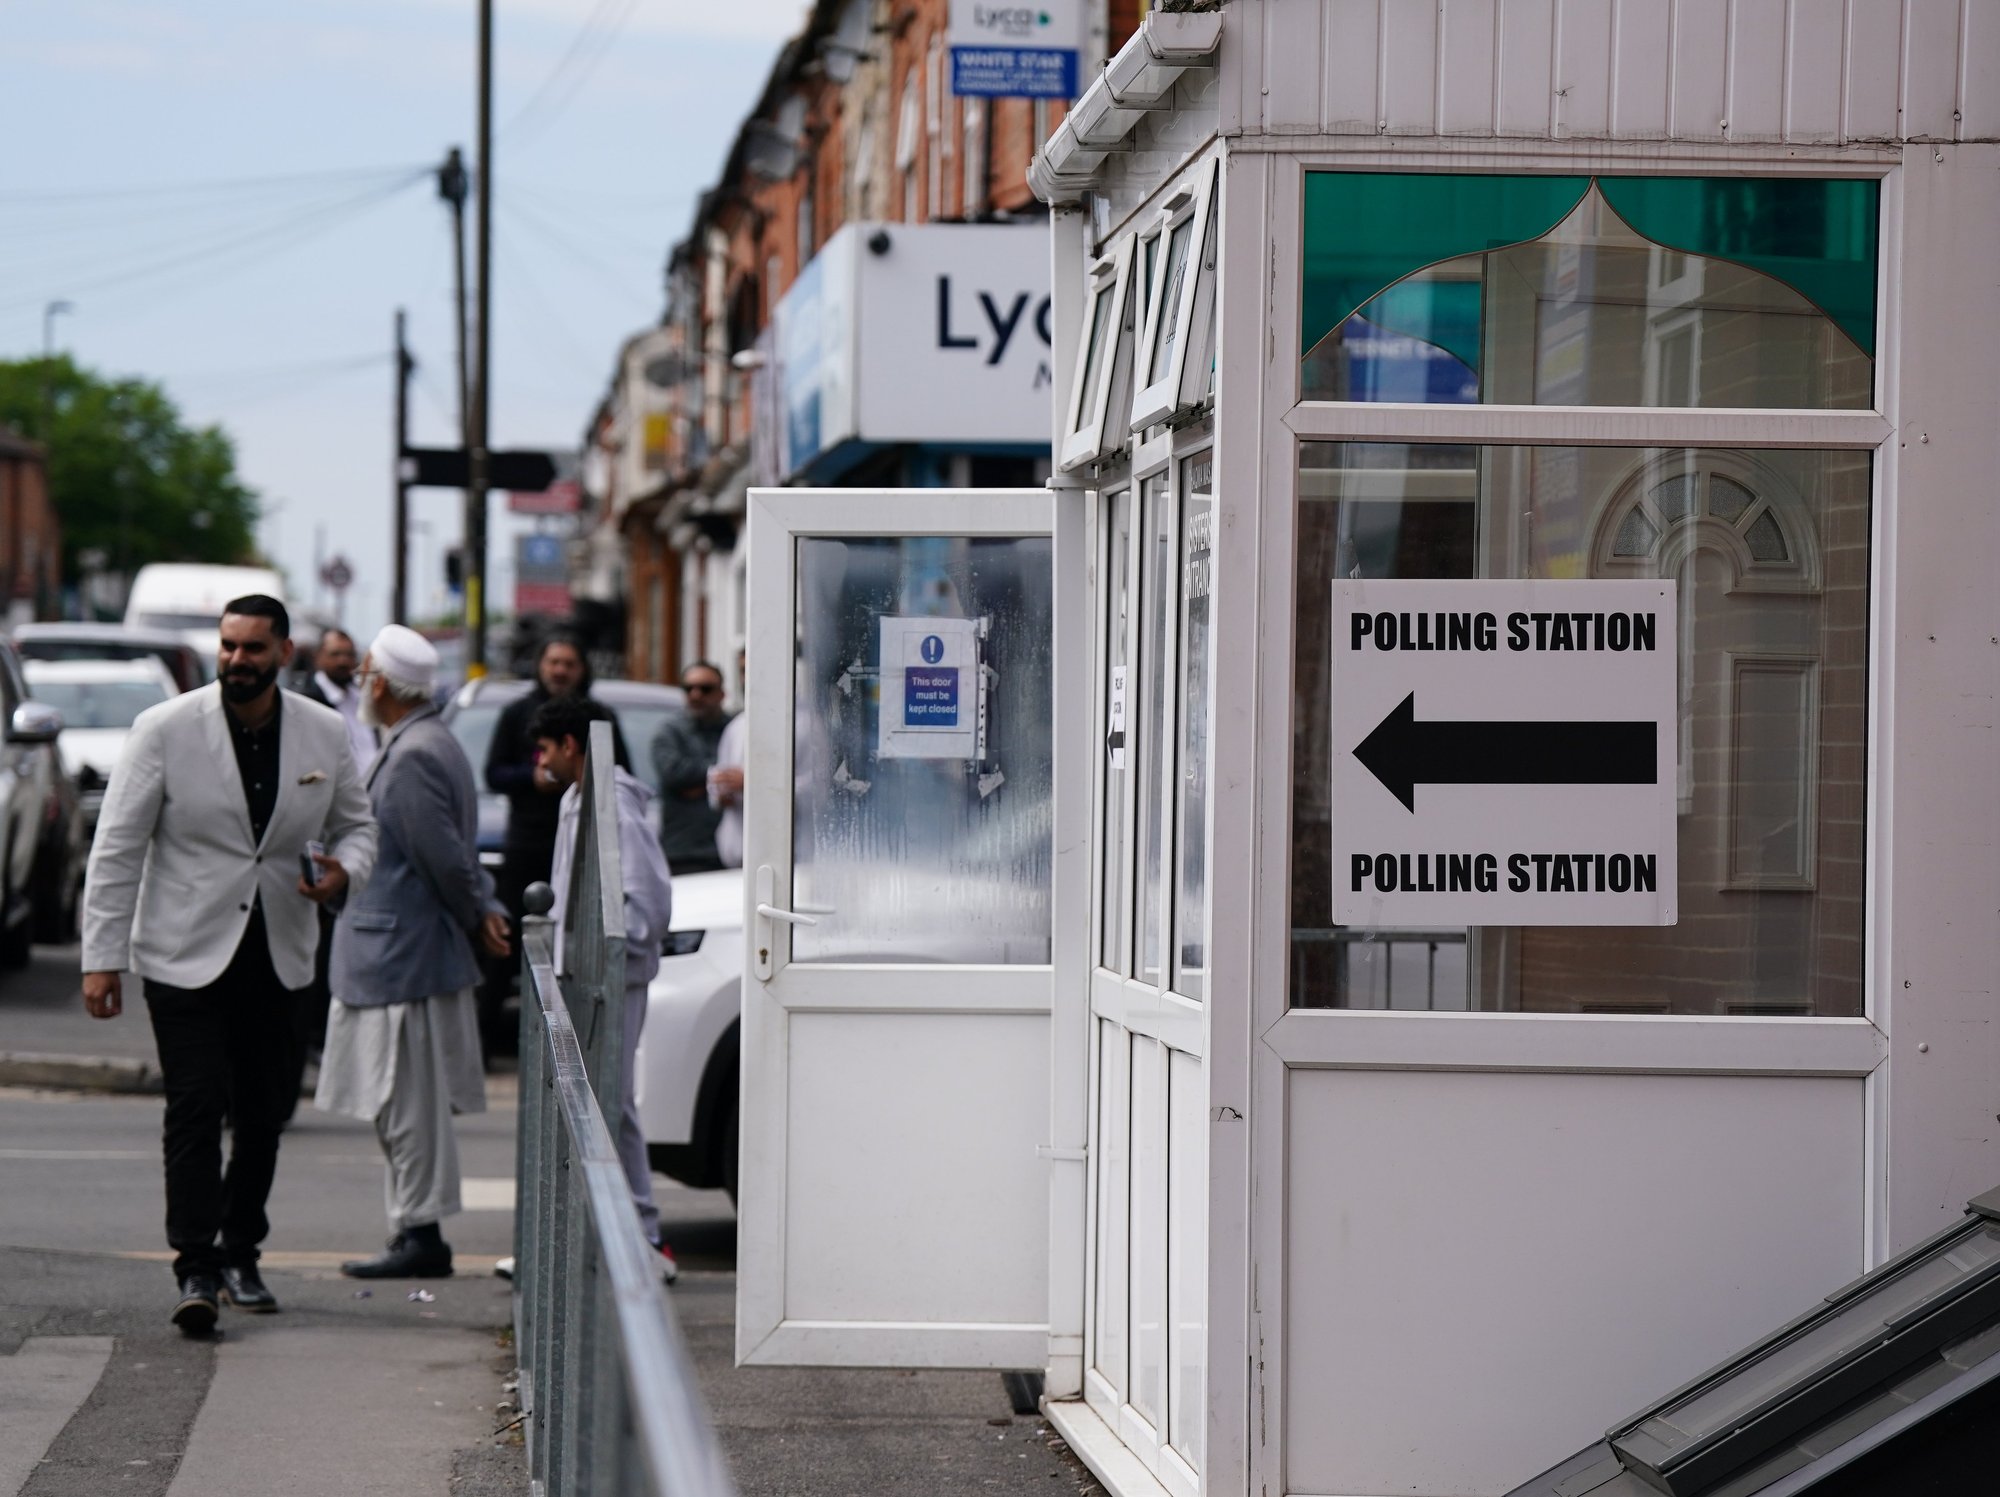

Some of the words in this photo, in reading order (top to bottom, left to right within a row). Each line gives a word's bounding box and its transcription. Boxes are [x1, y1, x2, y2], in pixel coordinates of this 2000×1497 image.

[1189, 510, 1212, 554] SISTERS
[1351, 612, 1497, 651] POLLING
[1507, 612, 1656, 651] STATION
[912, 677, 930, 686] This
[932, 678, 951, 686] door
[916, 691, 937, 700] must
[939, 691, 949, 700] be
[909, 704, 927, 715] kept
[929, 704, 956, 713] closed
[1351, 853, 1498, 892] POLLING
[1508, 853, 1656, 892] STATION
